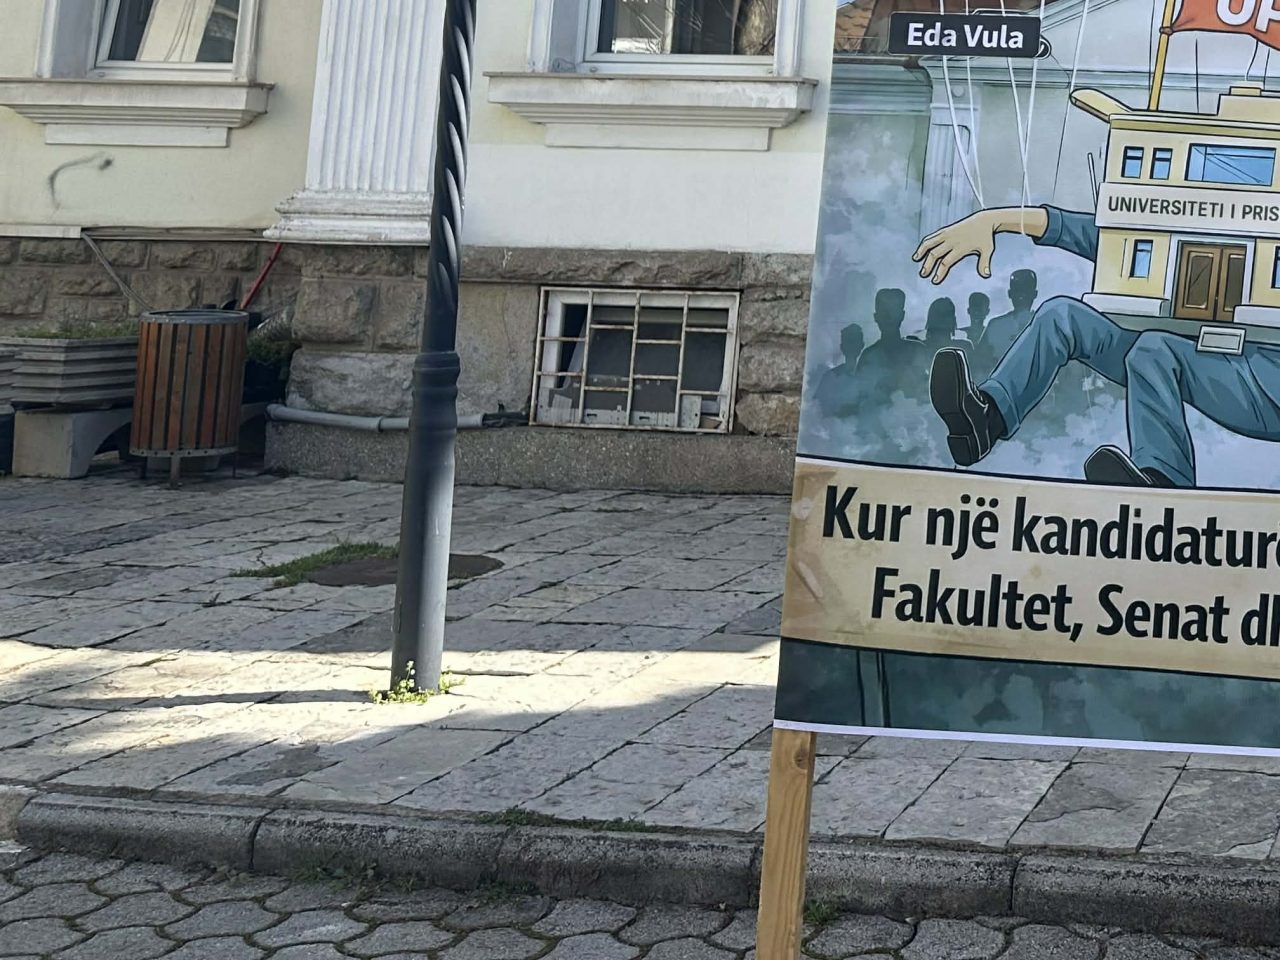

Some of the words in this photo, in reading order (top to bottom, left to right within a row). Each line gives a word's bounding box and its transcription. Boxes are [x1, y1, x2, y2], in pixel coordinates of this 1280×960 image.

[907, 22, 957, 47] Eda
[963, 24, 1024, 48] Vula
[1108, 195, 1224, 218] UNIVERSITETI
[1230, 203, 1236, 219] I
[822, 485, 911, 542] Kur
[925, 494, 999, 560] një
[871, 567, 1083, 642] Fakultet,
[1096, 584, 1229, 643] Senat
